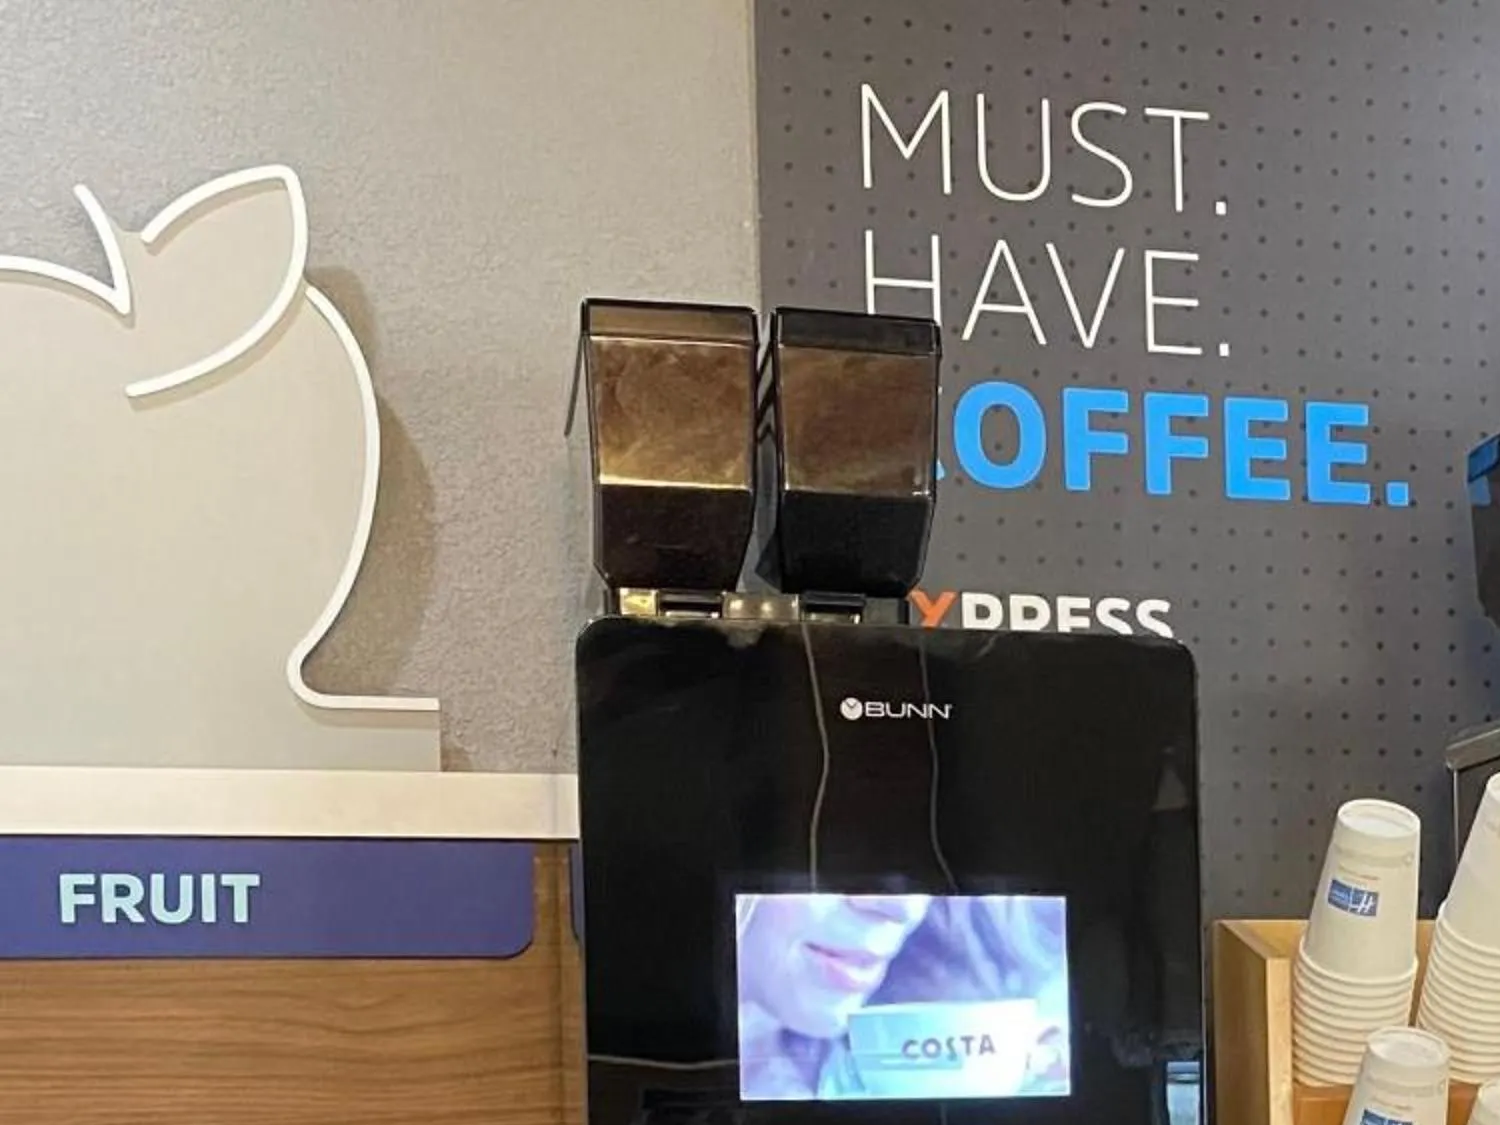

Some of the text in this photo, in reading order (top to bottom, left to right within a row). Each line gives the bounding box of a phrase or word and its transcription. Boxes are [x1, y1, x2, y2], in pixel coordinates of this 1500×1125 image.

[861, 83, 1228, 215] MUST.
[865, 230, 1230, 357] HAVE.
[936, 381, 1409, 506] OFFEE.
[908, 590, 1177, 640] XPRESS
[865, 701, 951, 720] BUNN
[59, 873, 261, 924] FRUIT
[901, 1034, 997, 1061] COSTA
